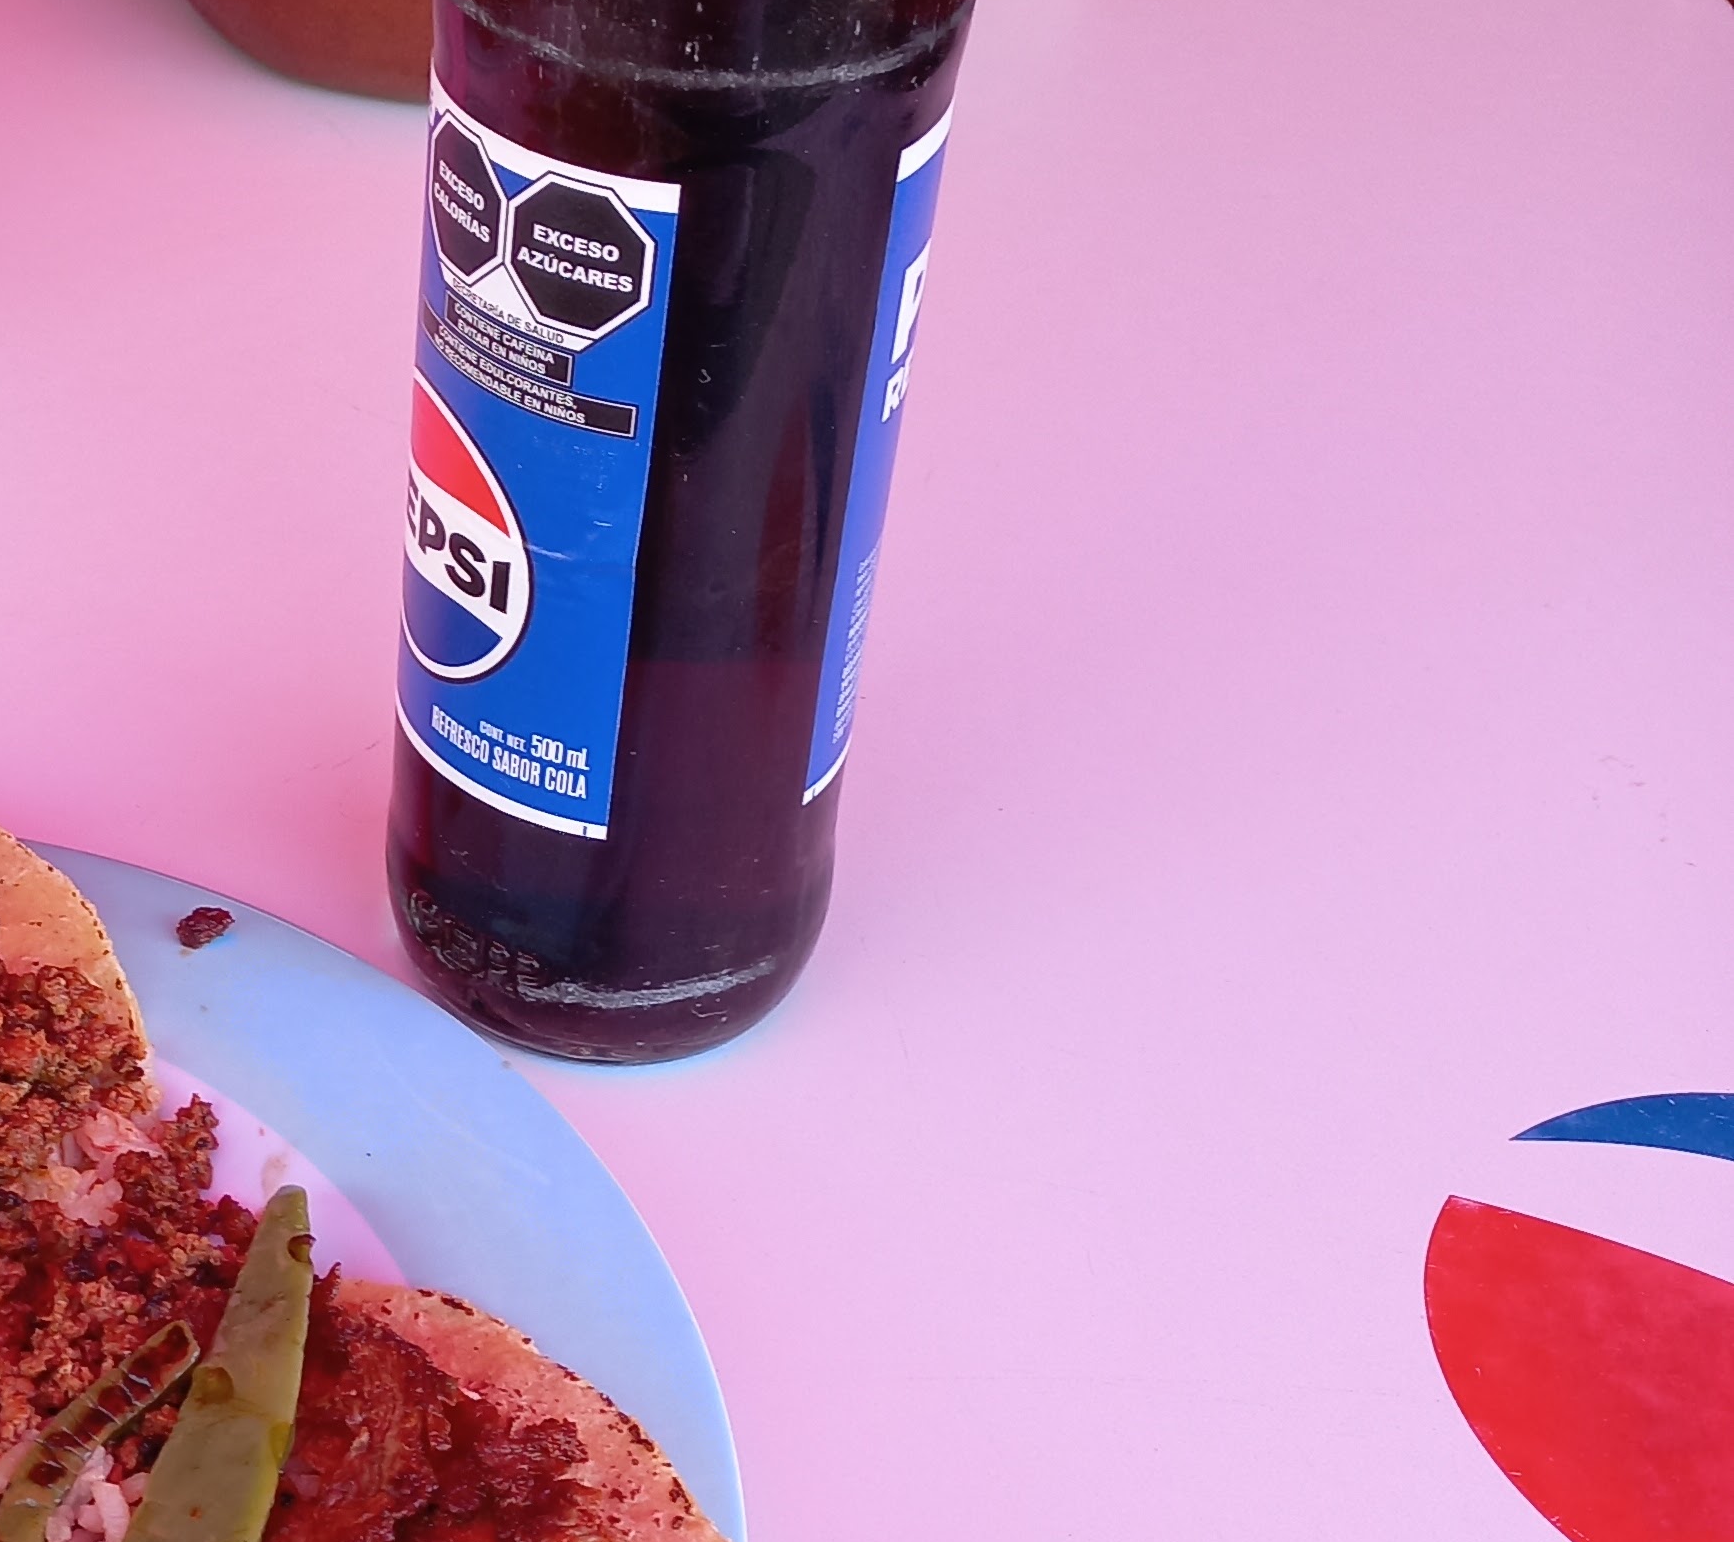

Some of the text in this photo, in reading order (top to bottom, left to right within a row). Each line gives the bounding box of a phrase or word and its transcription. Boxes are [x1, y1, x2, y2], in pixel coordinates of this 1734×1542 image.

[439, 159, 485, 211] EXCESO
[434, 182, 491, 244] CALORÍAS
[532, 223, 620, 263] EXCESO
[517, 246, 634, 294] AZÚCARES
[506, 313, 522, 329] DE
[524, 321, 565, 345] SALUD
[490, 340, 508, 358] EN
[508, 350, 547, 375] NIÑOS
[523, 395, 542, 411] EN
[543, 404, 587, 425] NIÑOS
[407, 467, 511, 615] EPSI
[431, 704, 588, 800] REFRESCO SABOR COLA
[530, 734, 565, 764] 500
